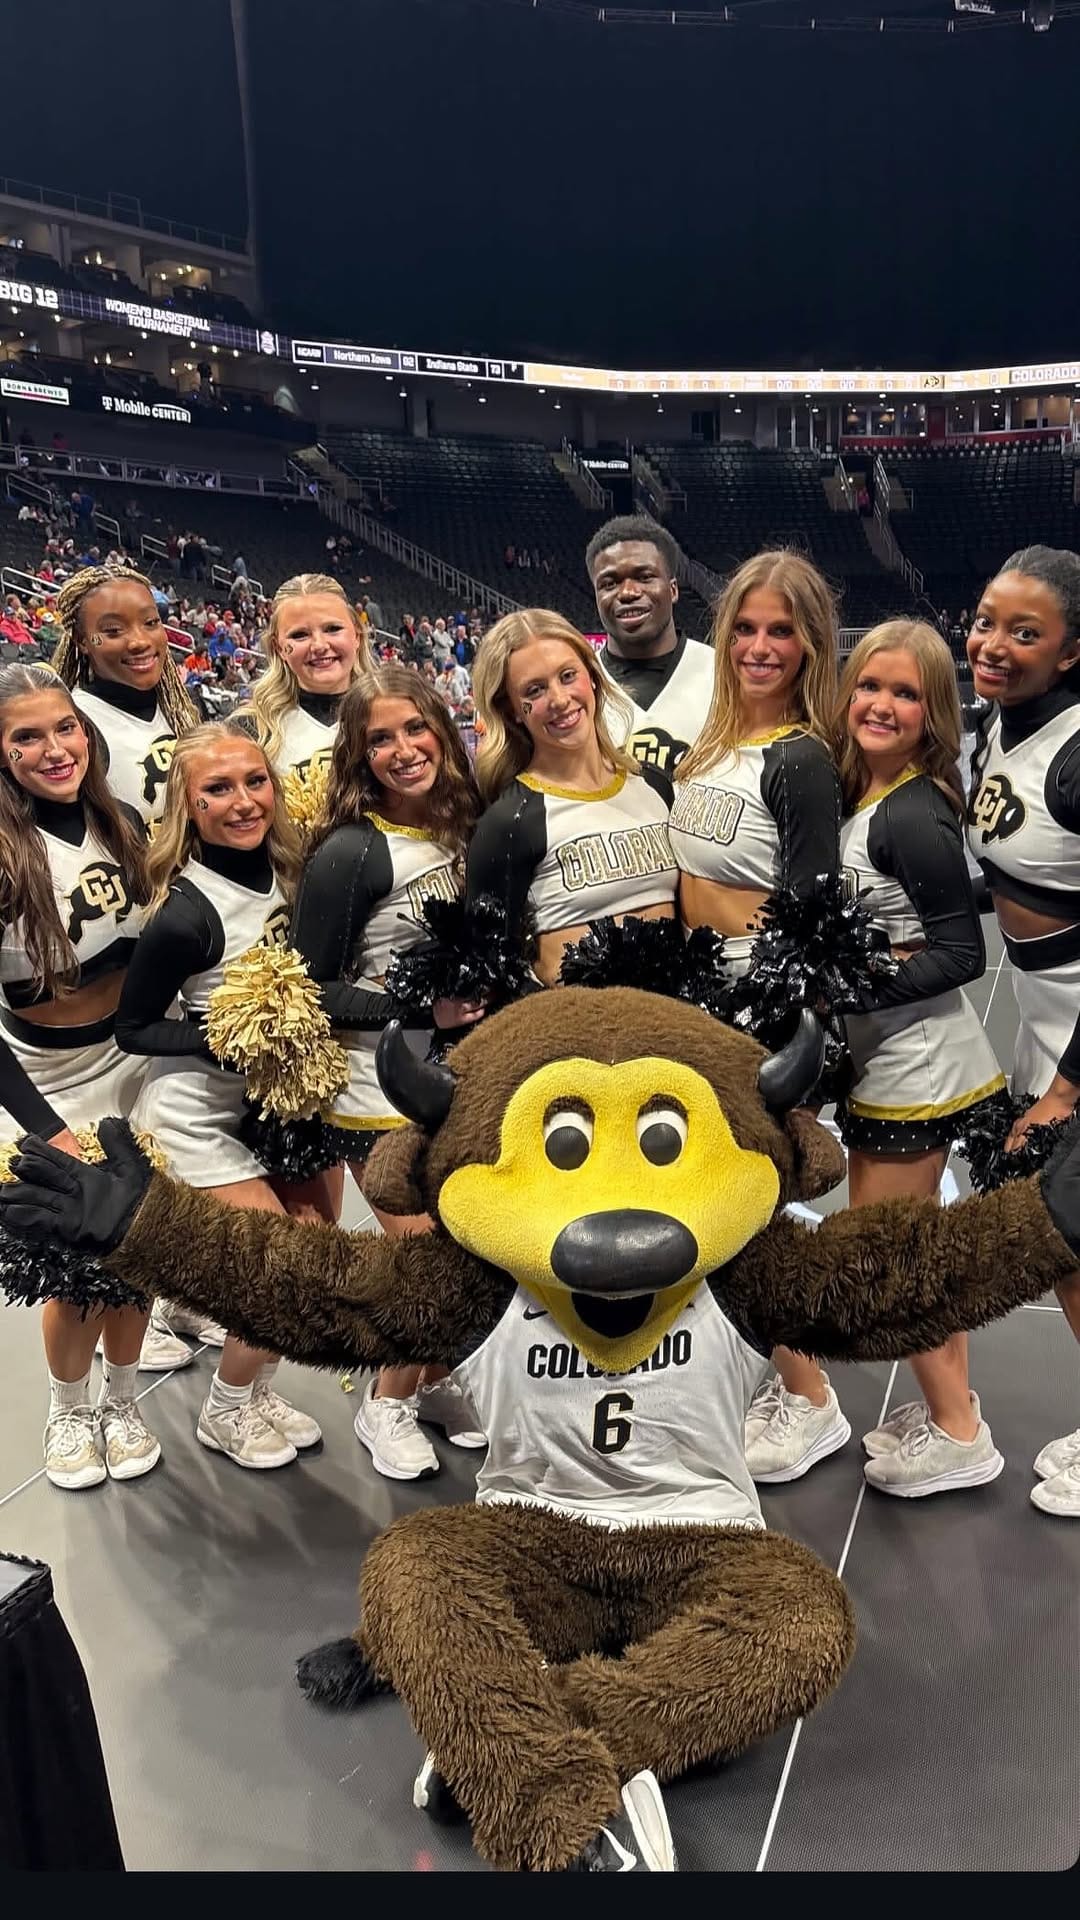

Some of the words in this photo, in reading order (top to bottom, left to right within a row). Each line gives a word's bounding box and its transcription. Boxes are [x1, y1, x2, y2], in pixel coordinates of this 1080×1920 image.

[0, 279, 33, 304] BIG
[35, 287, 59, 309] 12
[105, 298, 152, 318] WOMEN'S
[152, 308, 211, 331] BASKETBALL
[128, 314, 192, 337] TOURNAMENT
[334, 350, 370, 363] Northern
[371, 356, 392, 365] Iowa
[426, 358, 456, 371] Indiana
[457, 361, 479, 373] State
[1012, 366, 1080, 383] COLORADO
[114, 398, 151, 418] Mobile
[151, 406, 189, 422] CENTER
[972, 778, 1009, 833] CU
[79, 867, 128, 914] CU
[591, 1391, 635, 1455] 6
